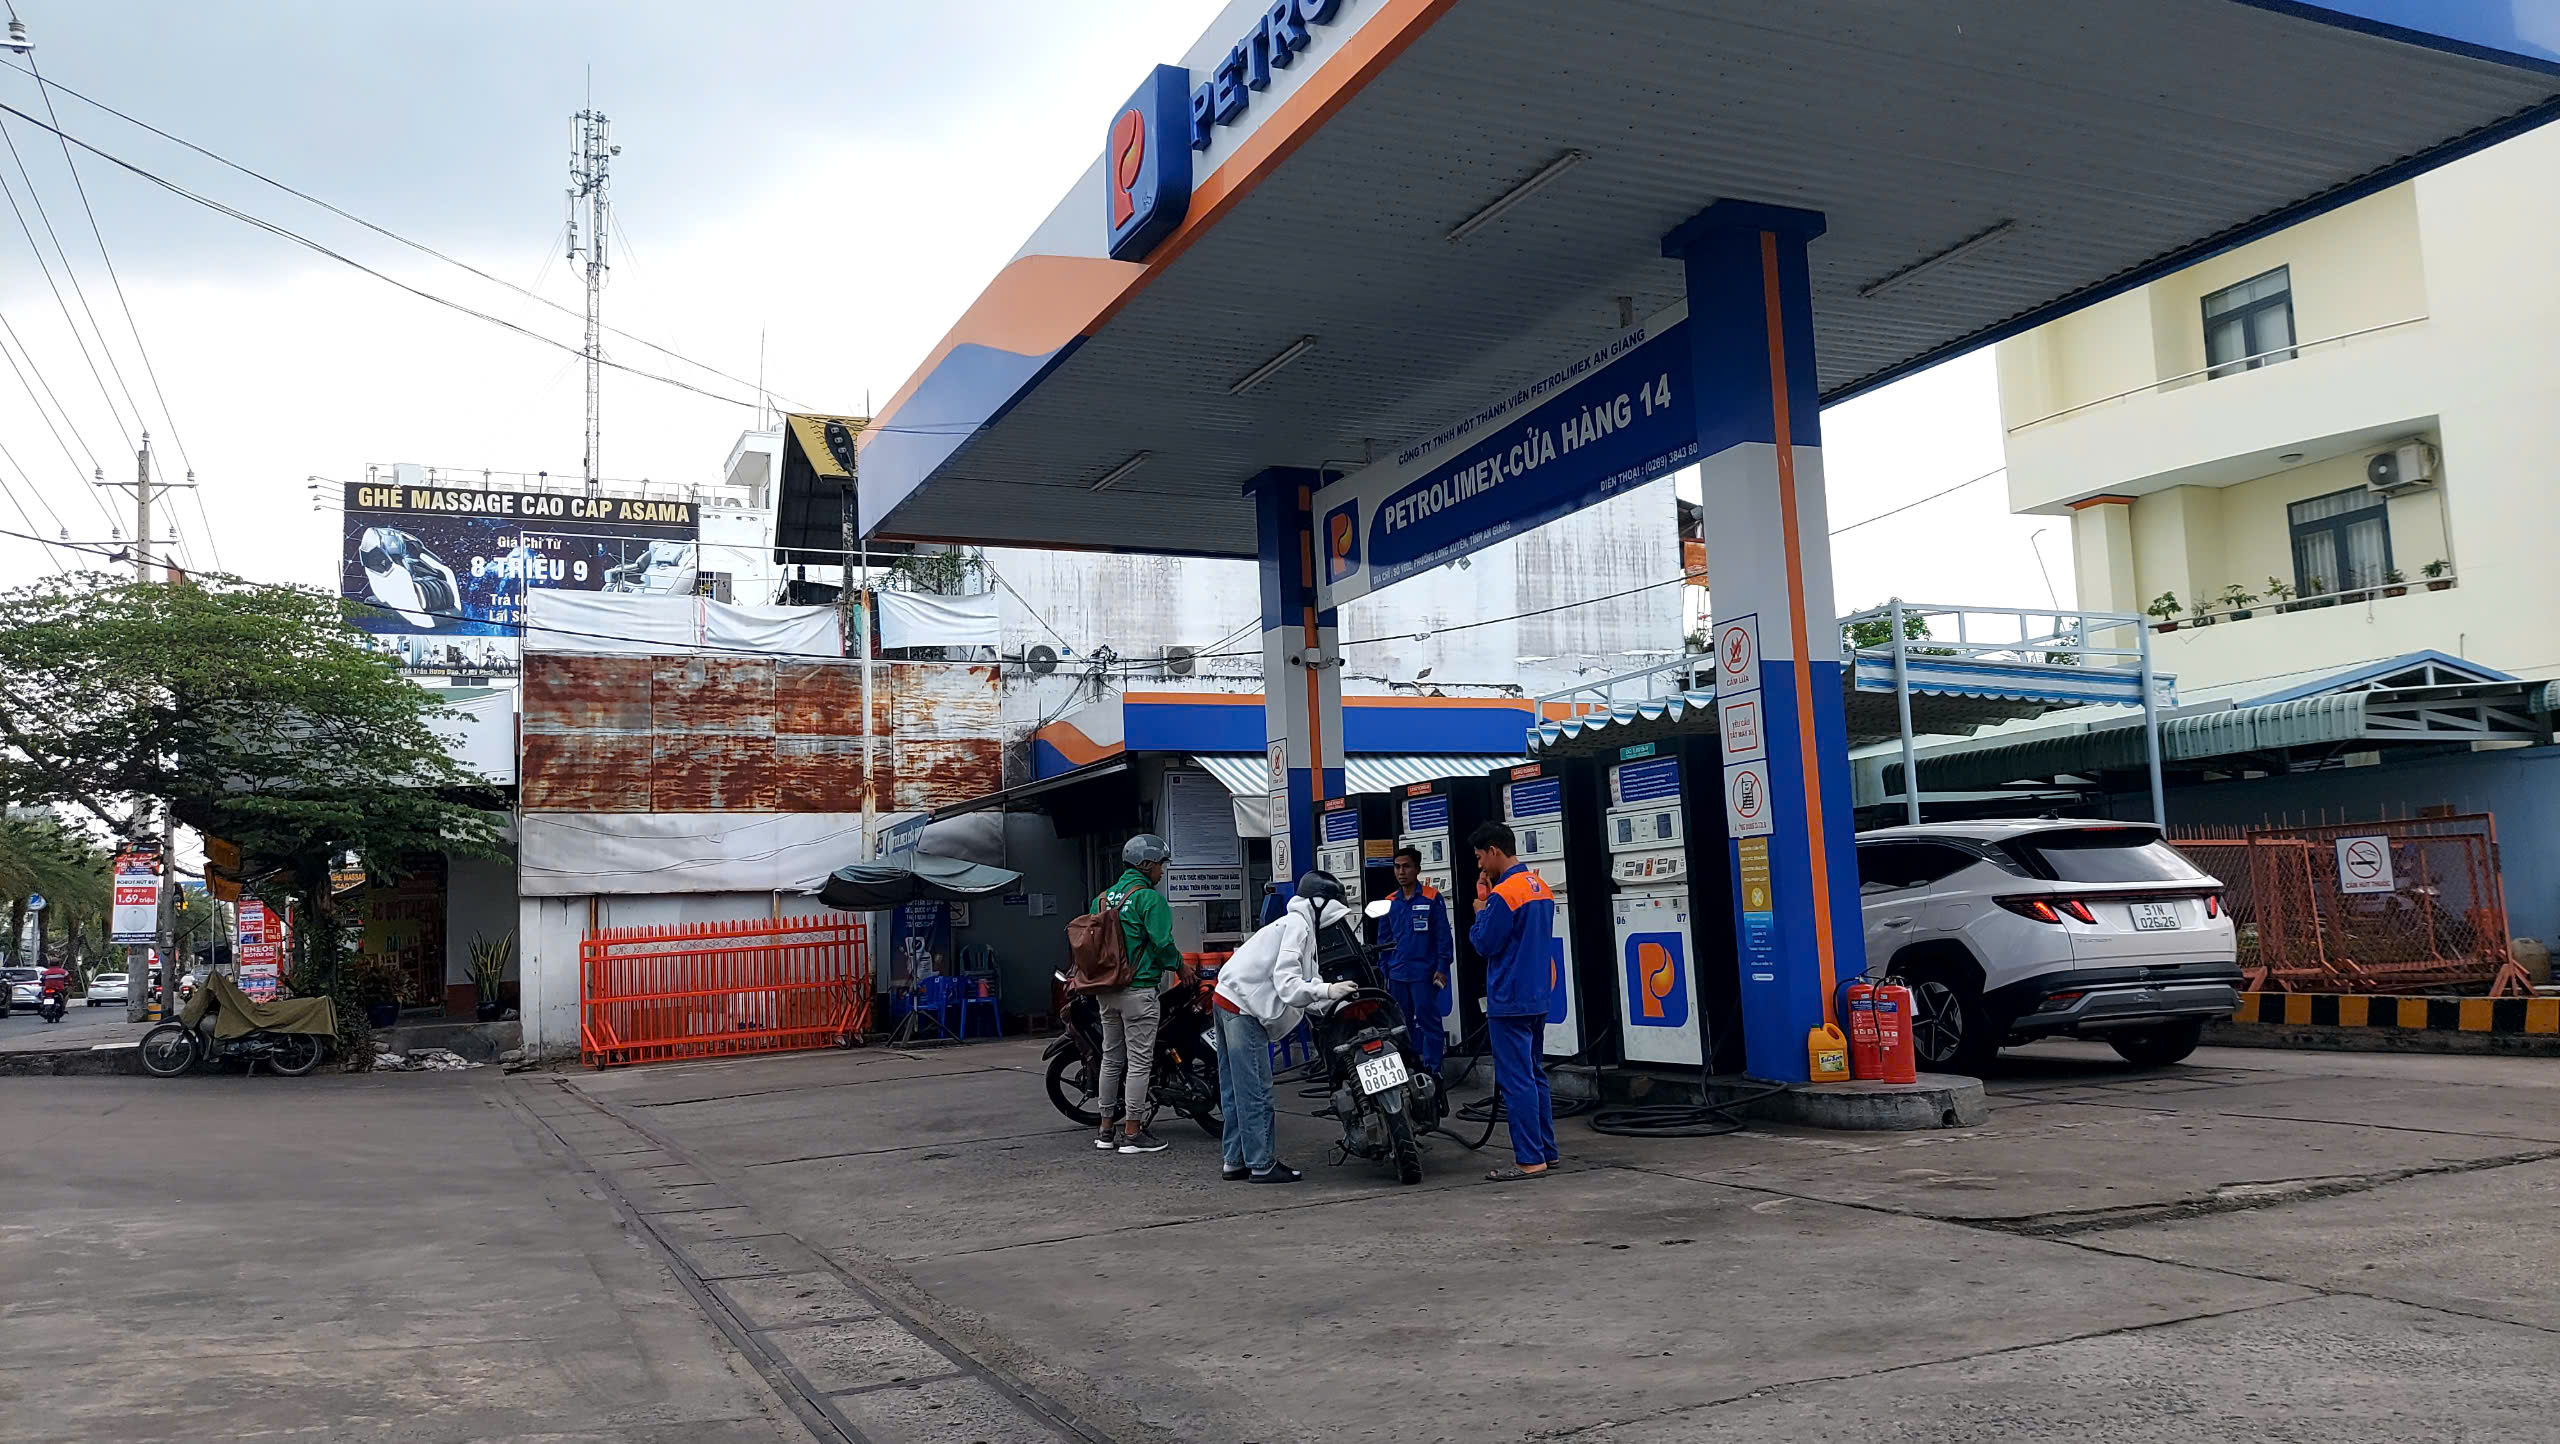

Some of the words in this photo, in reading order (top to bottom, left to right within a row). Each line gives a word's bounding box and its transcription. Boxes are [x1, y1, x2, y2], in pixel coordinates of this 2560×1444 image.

[1398, 447, 1420, 466] CÔNG
[1421, 440, 1433, 454] TY
[1433, 428, 1455, 448] TNHH
[1476, 400, 1507, 427] THÀNH
[1508, 388, 1530, 410] VIÊN
[1531, 356, 1591, 398] PETROLIMEX
[1593, 347, 1608, 366] AN
[1610, 328, 1646, 356] GIANG
[1561, 393, 1633, 454] HÀNG
[1639, 372, 1673, 418] 14
[1668, 446, 1687, 464] 3843
[411, 489, 514, 514] MASSAGE
[521, 495, 564, 517] CAO
[619, 501, 690, 523] ASAMA
[1482, 528, 1492, 541] AN
[1492, 520, 1511, 536] GIANG
[497, 535, 518, 549] Giá
[469, 555, 486, 579] 8
[573, 560, 588, 582] 9
[117, 893, 139, 904] 1.69
[1676, 913, 1687, 923] 07
[2143, 904, 2165, 916] 51N
[1616, 915, 1626, 925] 06
[2140, 916, 2176, 929] 026.26
[243, 945, 275, 953] ENEOS
[1364, 1068, 1405, 1092] 080.30
